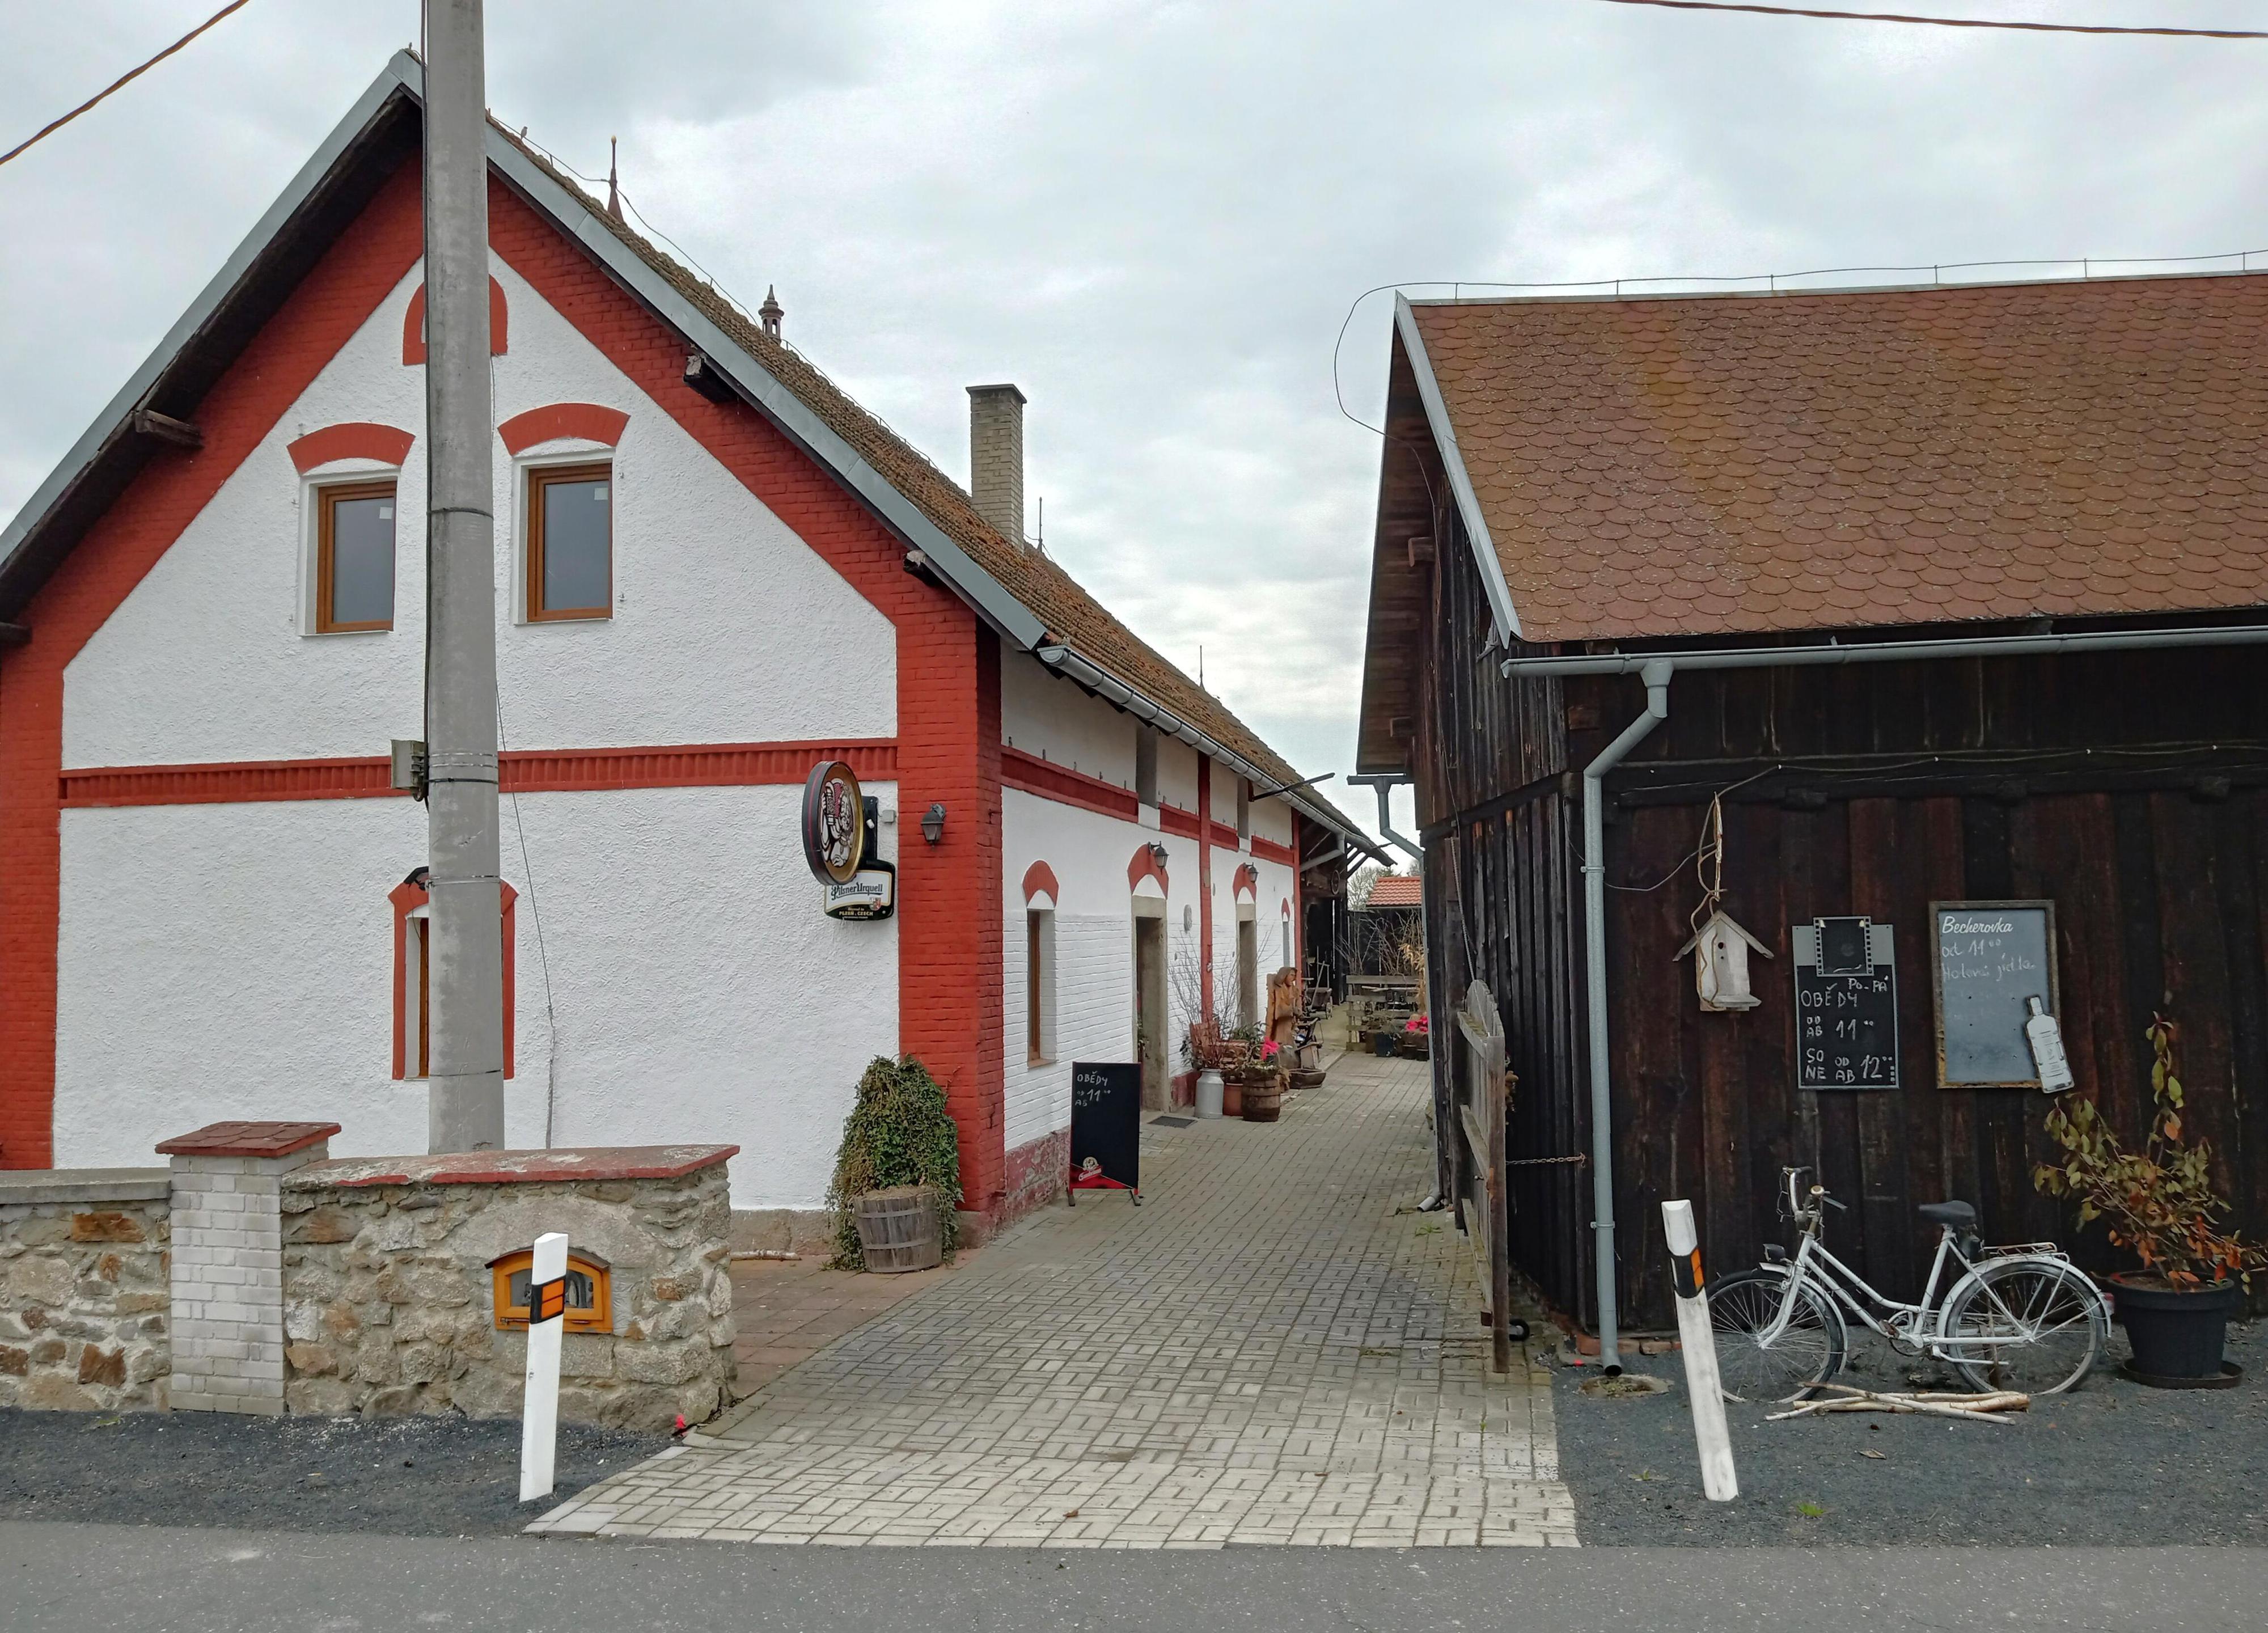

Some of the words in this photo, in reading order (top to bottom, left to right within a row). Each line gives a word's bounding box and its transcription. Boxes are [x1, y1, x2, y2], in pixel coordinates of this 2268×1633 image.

[831, 885, 857, 900] Pilsner
[856, 882, 883, 896] Urquell
[1942, 916, 2013, 934] Becherovka
[1806, 1025, 1823, 1038] AB
[1806, 1048, 1824, 1063] SO
[1834, 1056, 1850, 1067] OD
[1077, 1071, 1108, 1086] OBĚDY
[1805, 1065, 1827, 1080] NE
[1835, 1069, 1856, 1084] AB
